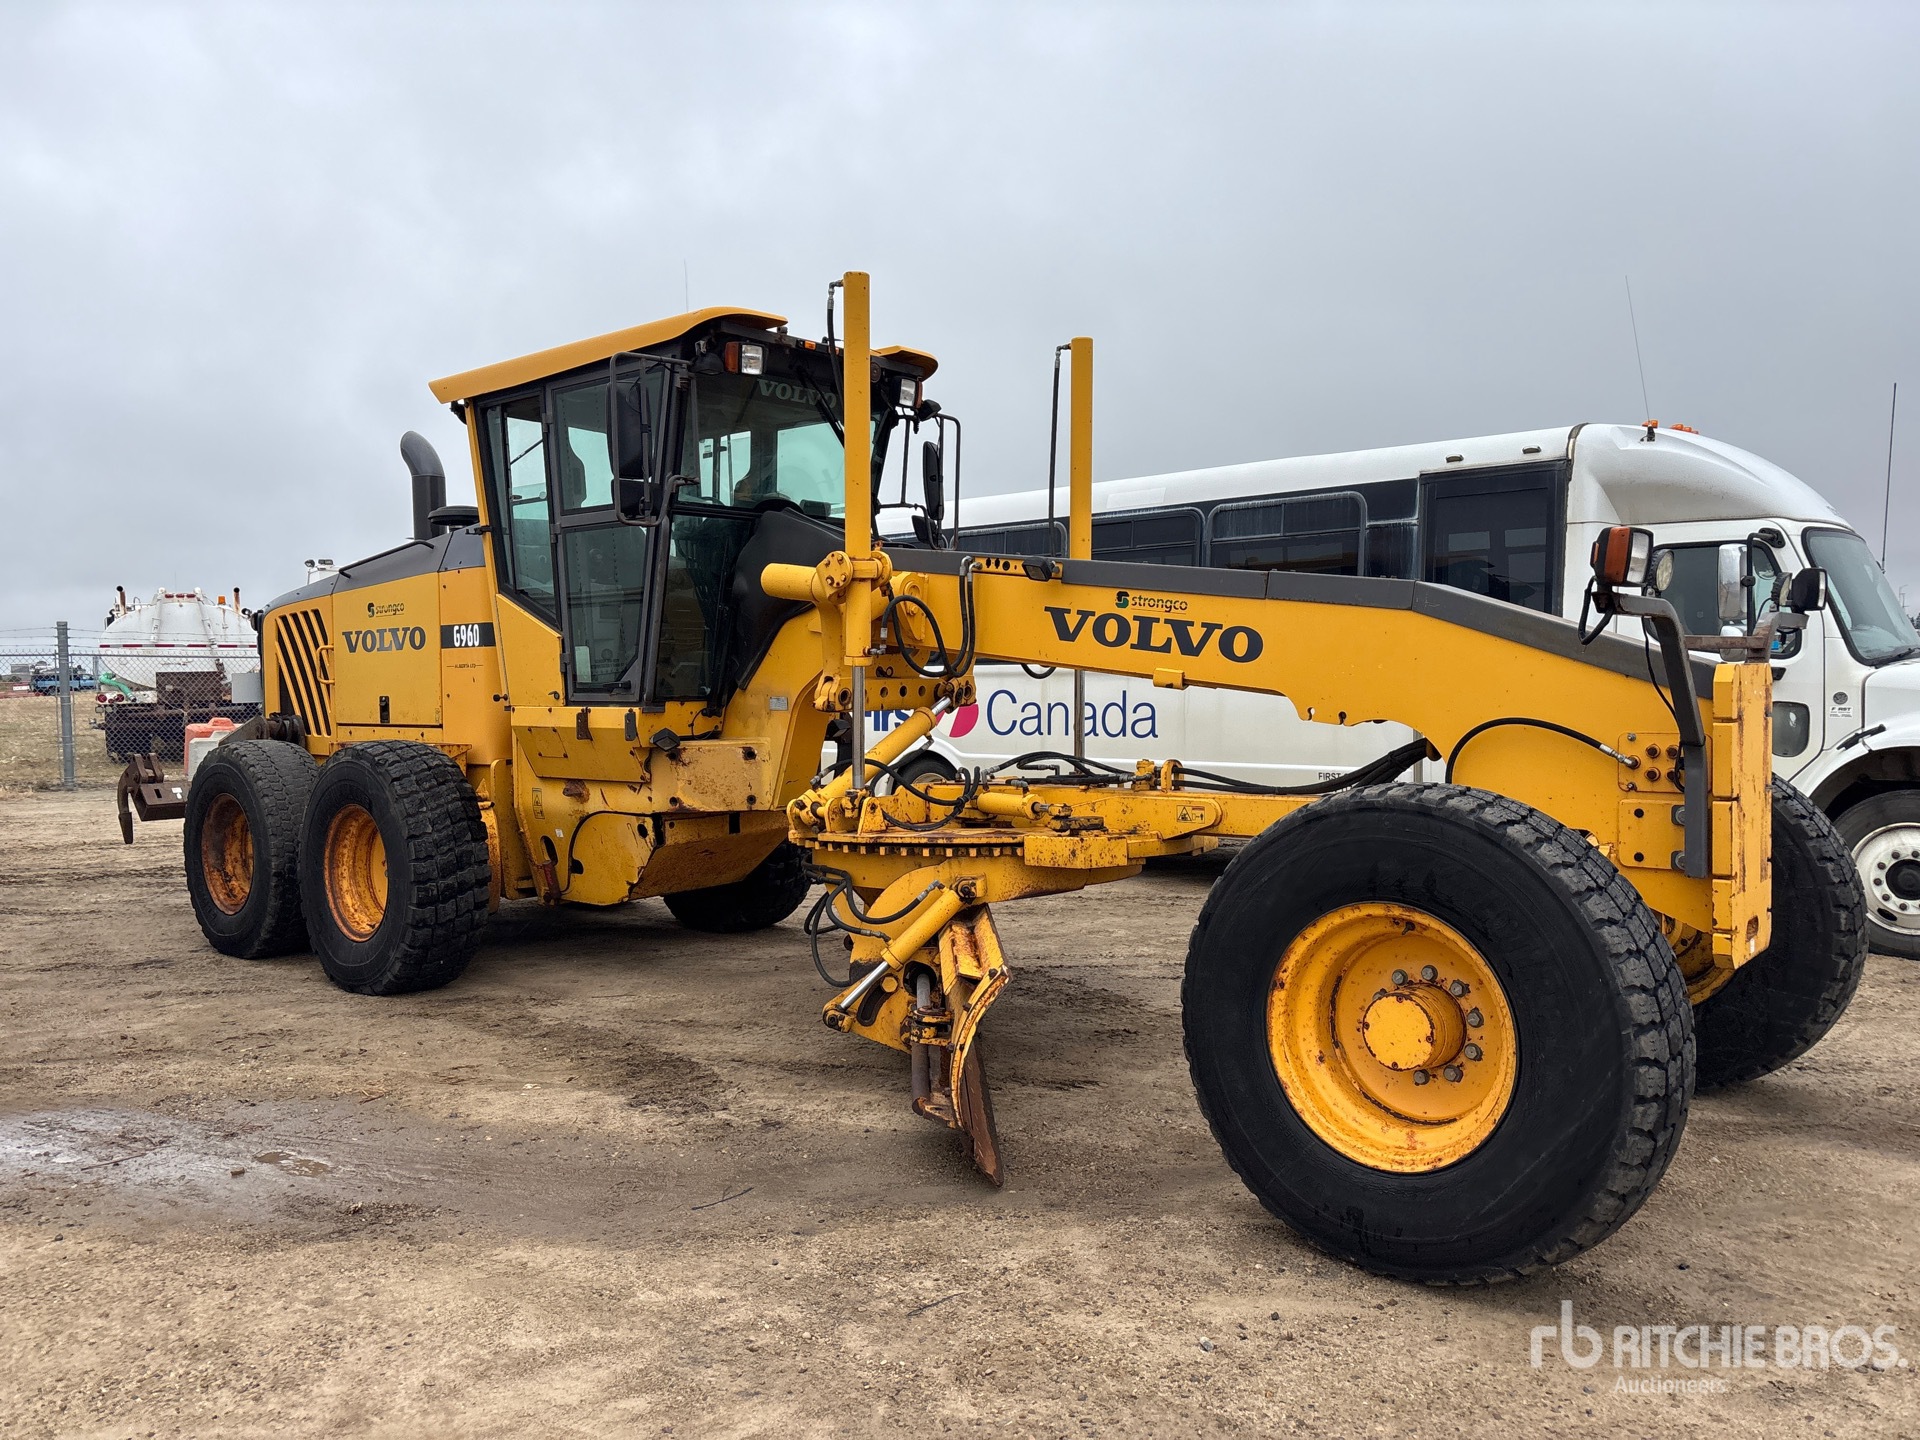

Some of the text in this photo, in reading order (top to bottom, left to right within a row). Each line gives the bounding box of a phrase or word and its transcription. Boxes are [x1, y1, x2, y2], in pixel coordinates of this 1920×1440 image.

[757, 379, 837, 409] VOLVO
[1131, 594, 1188, 613] strongco
[342, 626, 426, 653] VOLVO
[453, 624, 480, 647] G960
[1044, 606, 1264, 663] VOLVO
[987, 689, 1158, 738] Canada
